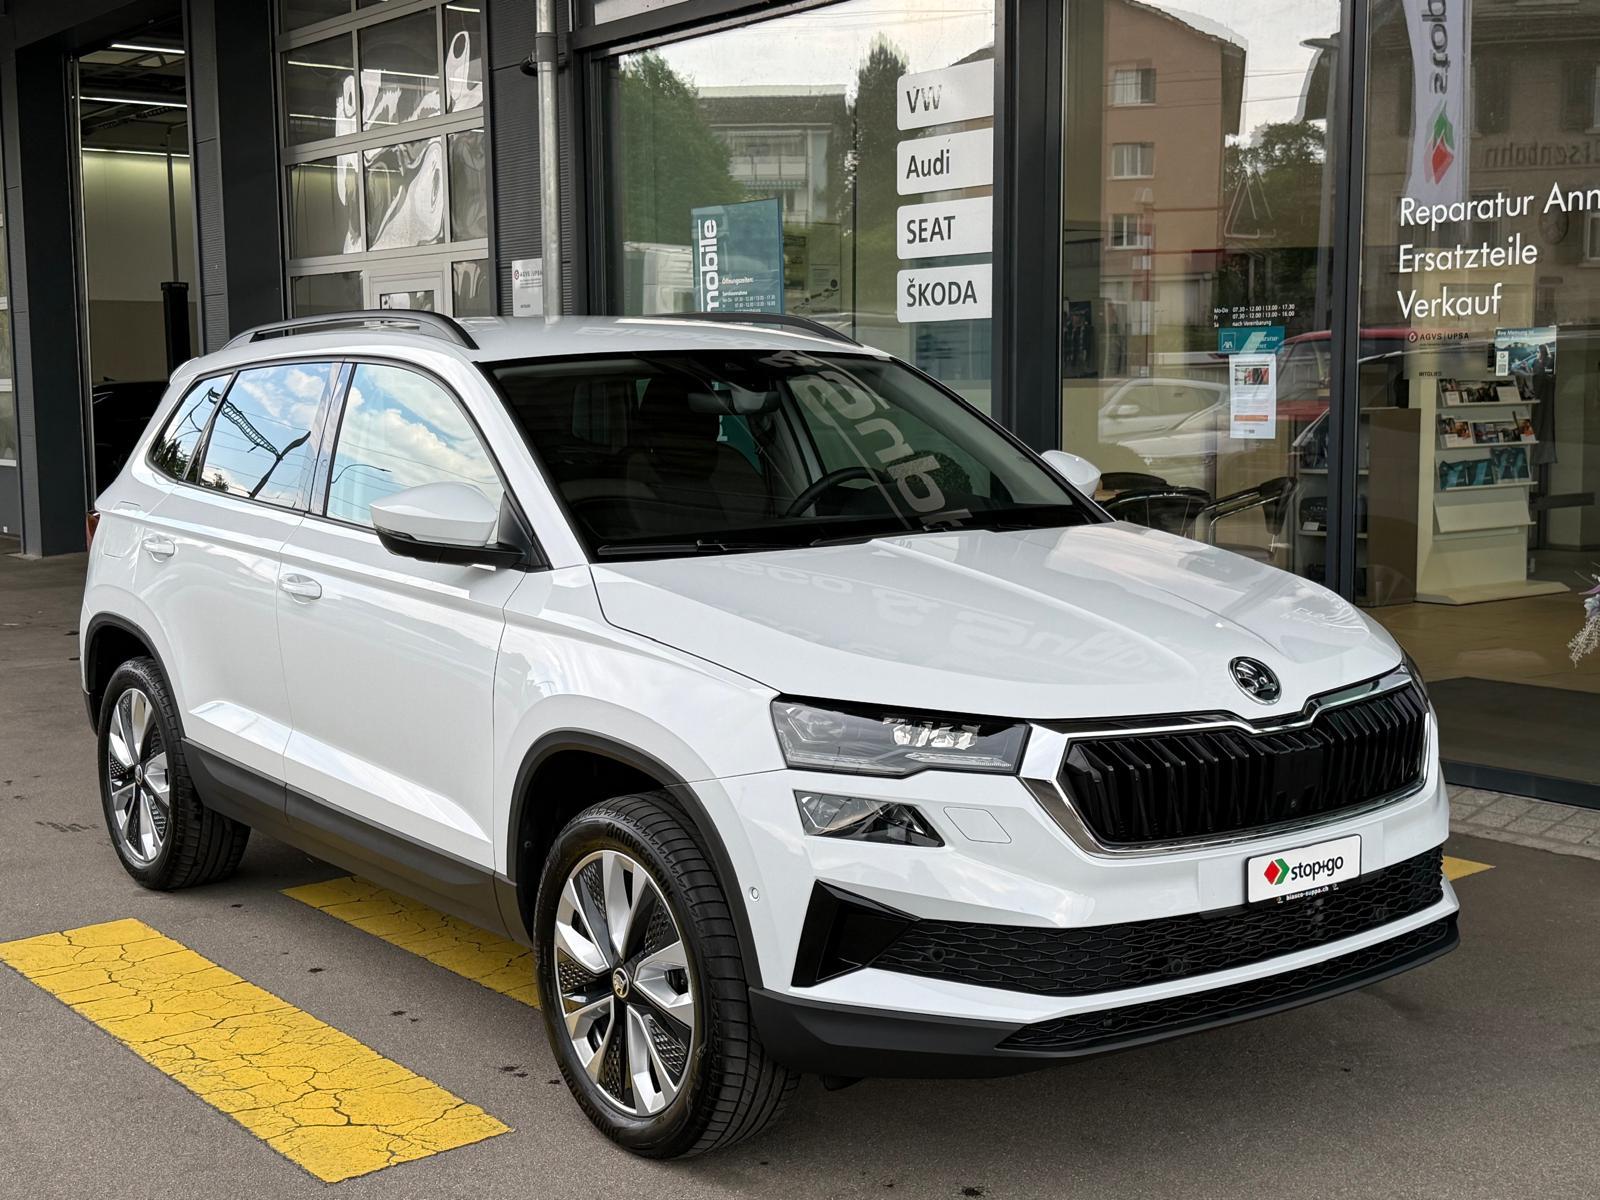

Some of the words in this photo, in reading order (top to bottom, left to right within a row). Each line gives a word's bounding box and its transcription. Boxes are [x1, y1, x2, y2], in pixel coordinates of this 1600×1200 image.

[906, 85, 942, 113] VW
[906, 149, 951, 179] Audi
[1400, 192, 1535, 231] Reparatur
[906, 215, 956, 244] SEAT
[1399, 232, 1538, 273] Ersatzteile
[906, 278, 977, 307] ŠKODA
[1396, 282, 1503, 320] Verkauf
[1419, 332, 1442, 341] AGVS
[1447, 332, 1470, 340] UPSA
[1291, 856, 1344, 881] stop+go
